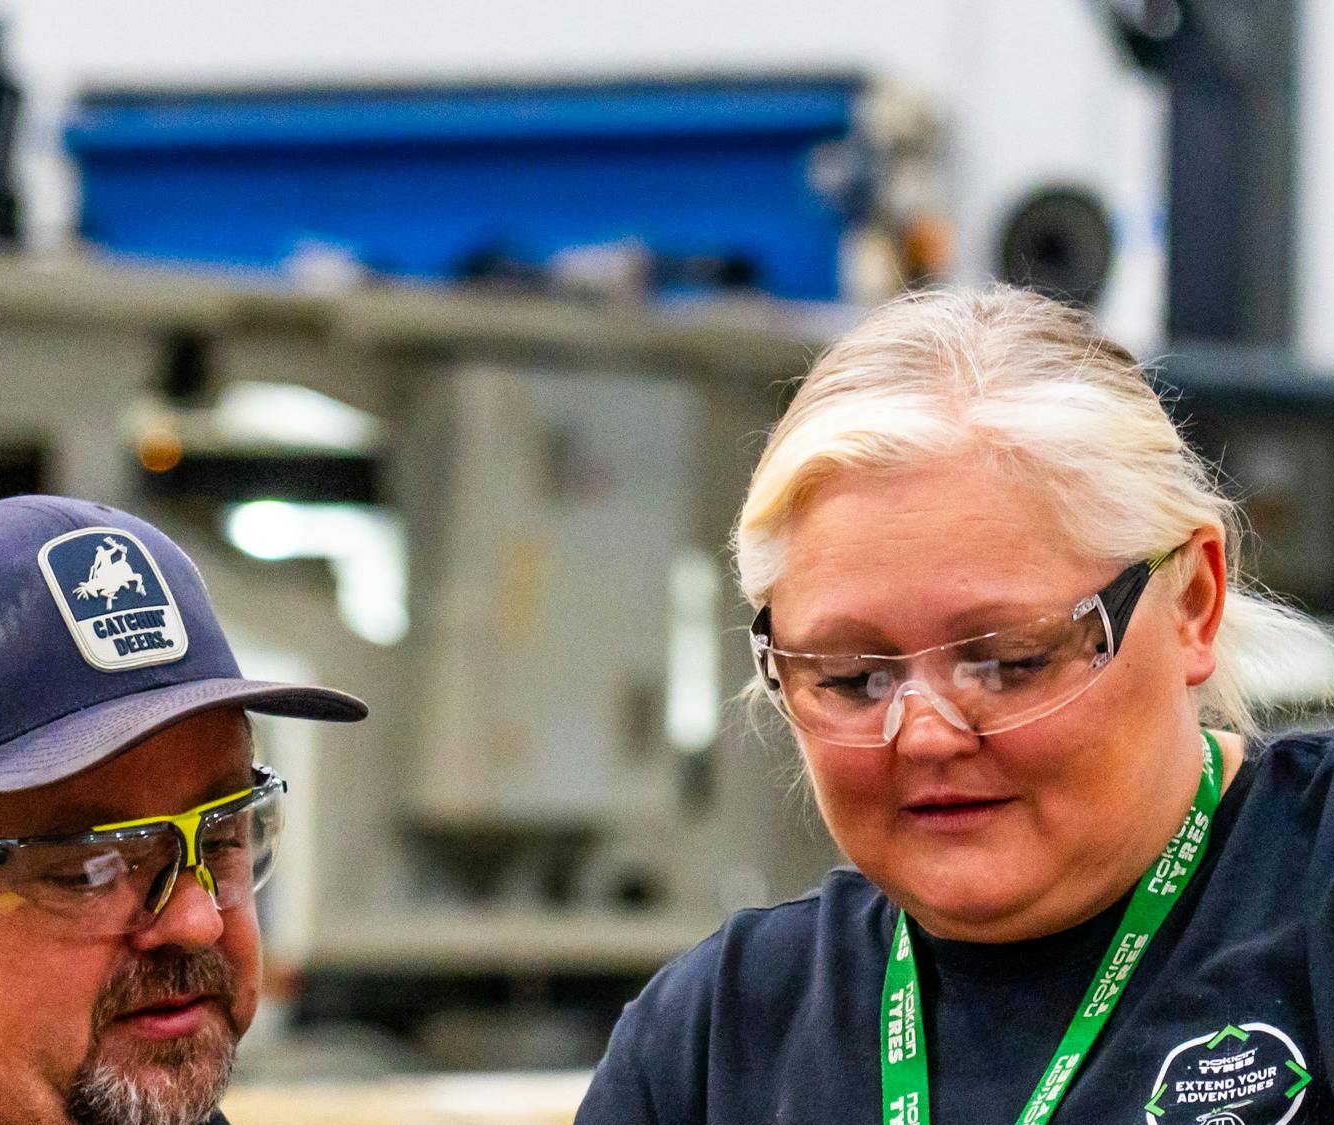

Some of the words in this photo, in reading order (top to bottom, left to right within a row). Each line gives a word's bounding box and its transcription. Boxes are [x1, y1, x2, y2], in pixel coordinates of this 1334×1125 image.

[1161, 810, 1209, 896] TYRES
[888, 988, 903, 1065] TYRES
[1175, 1078, 1235, 1092] EXTEND
[1238, 1066, 1277, 1085] YOUR
[1176, 1078, 1274, 1104] ADVENTURES
